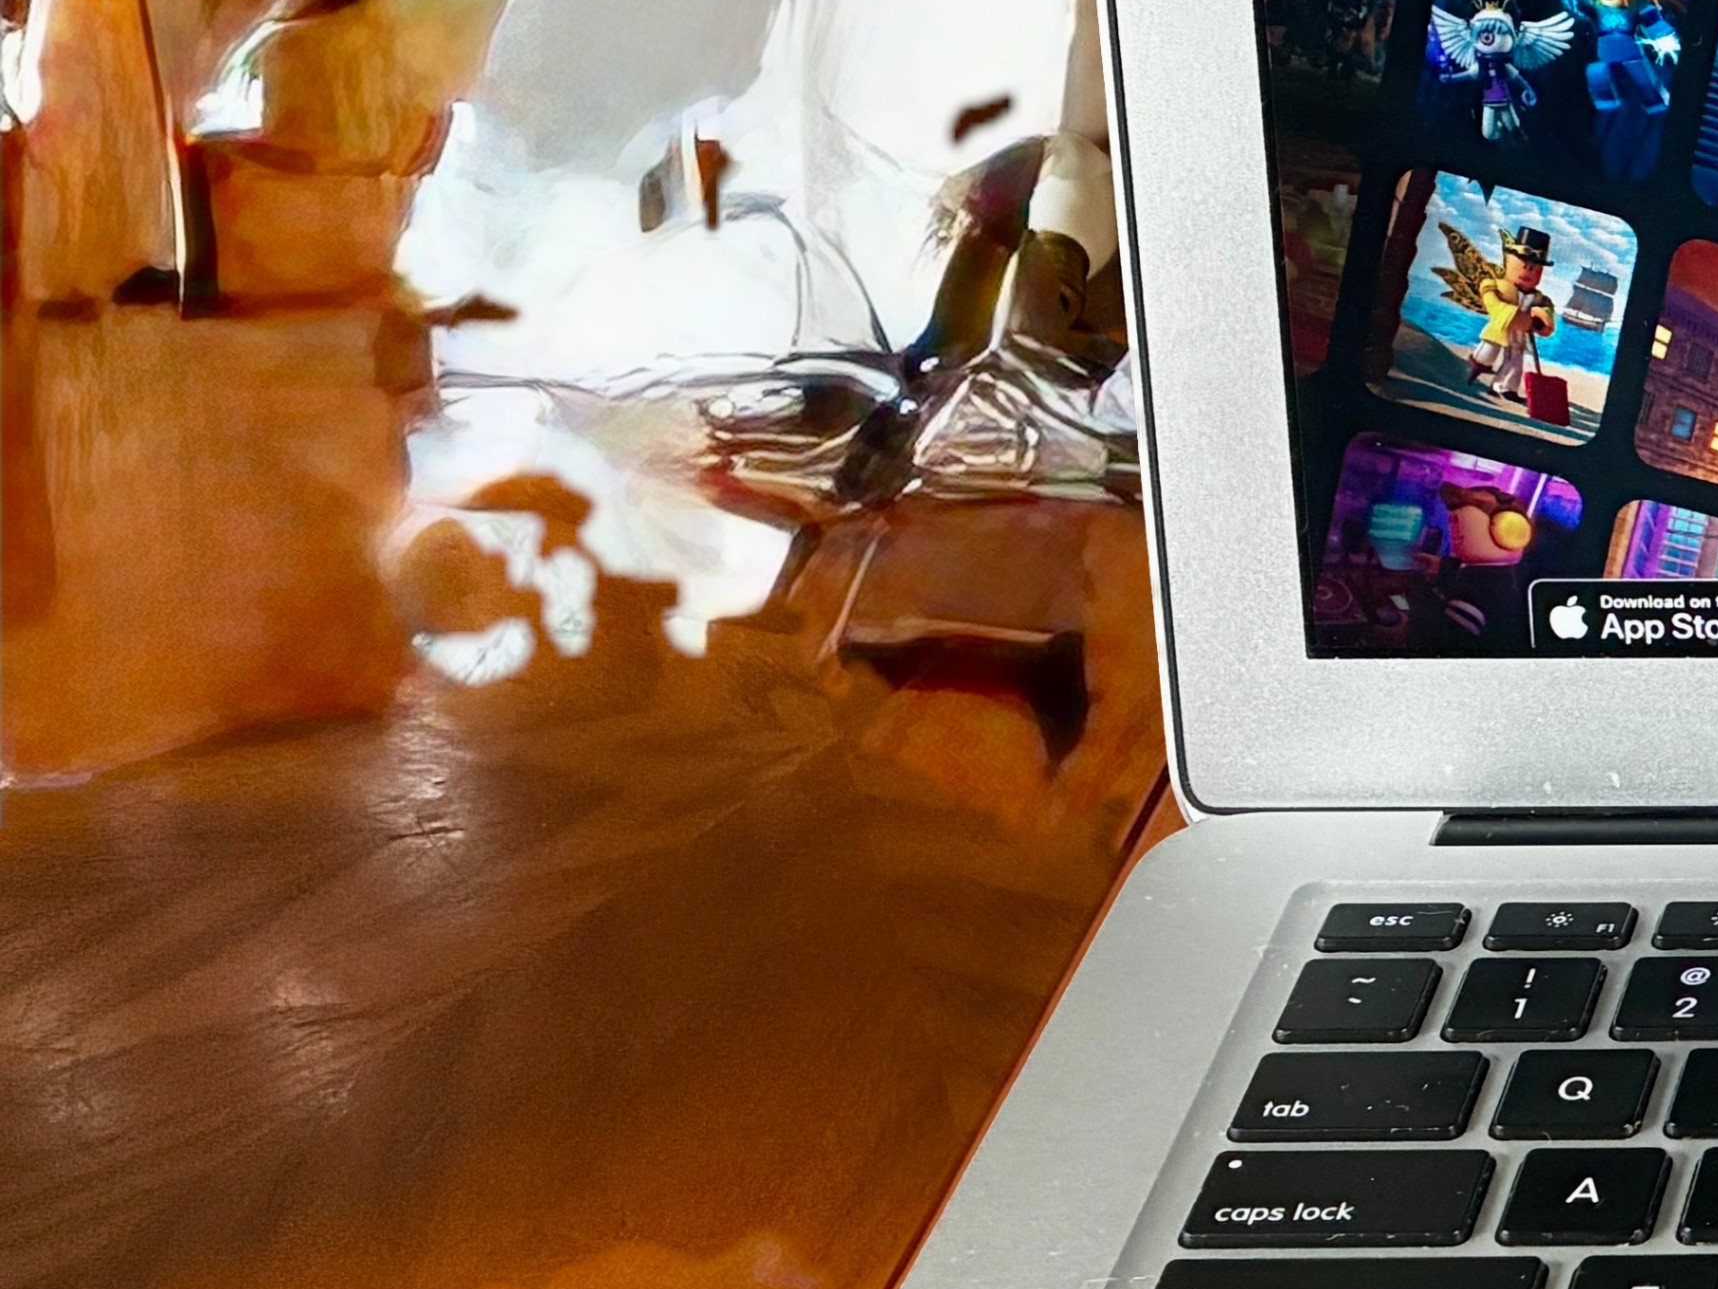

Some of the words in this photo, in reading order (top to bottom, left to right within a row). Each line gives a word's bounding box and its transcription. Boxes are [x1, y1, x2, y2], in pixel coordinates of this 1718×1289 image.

[1599, 594, 1686, 609] Download
[1688, 597, 1712, 609] on
[1600, 612, 1666, 645] App
[1369, 915, 1414, 926] esc
[1596, 923, 1615, 933] F1
[1672, 996, 1698, 1018] 2
[1558, 1076, 1594, 1101] Q
[1262, 1100, 1310, 1118] tab
[1565, 1176, 1599, 1204] A
[1214, 1207, 1286, 1226] caps
[1292, 1201, 1355, 1221] lock
